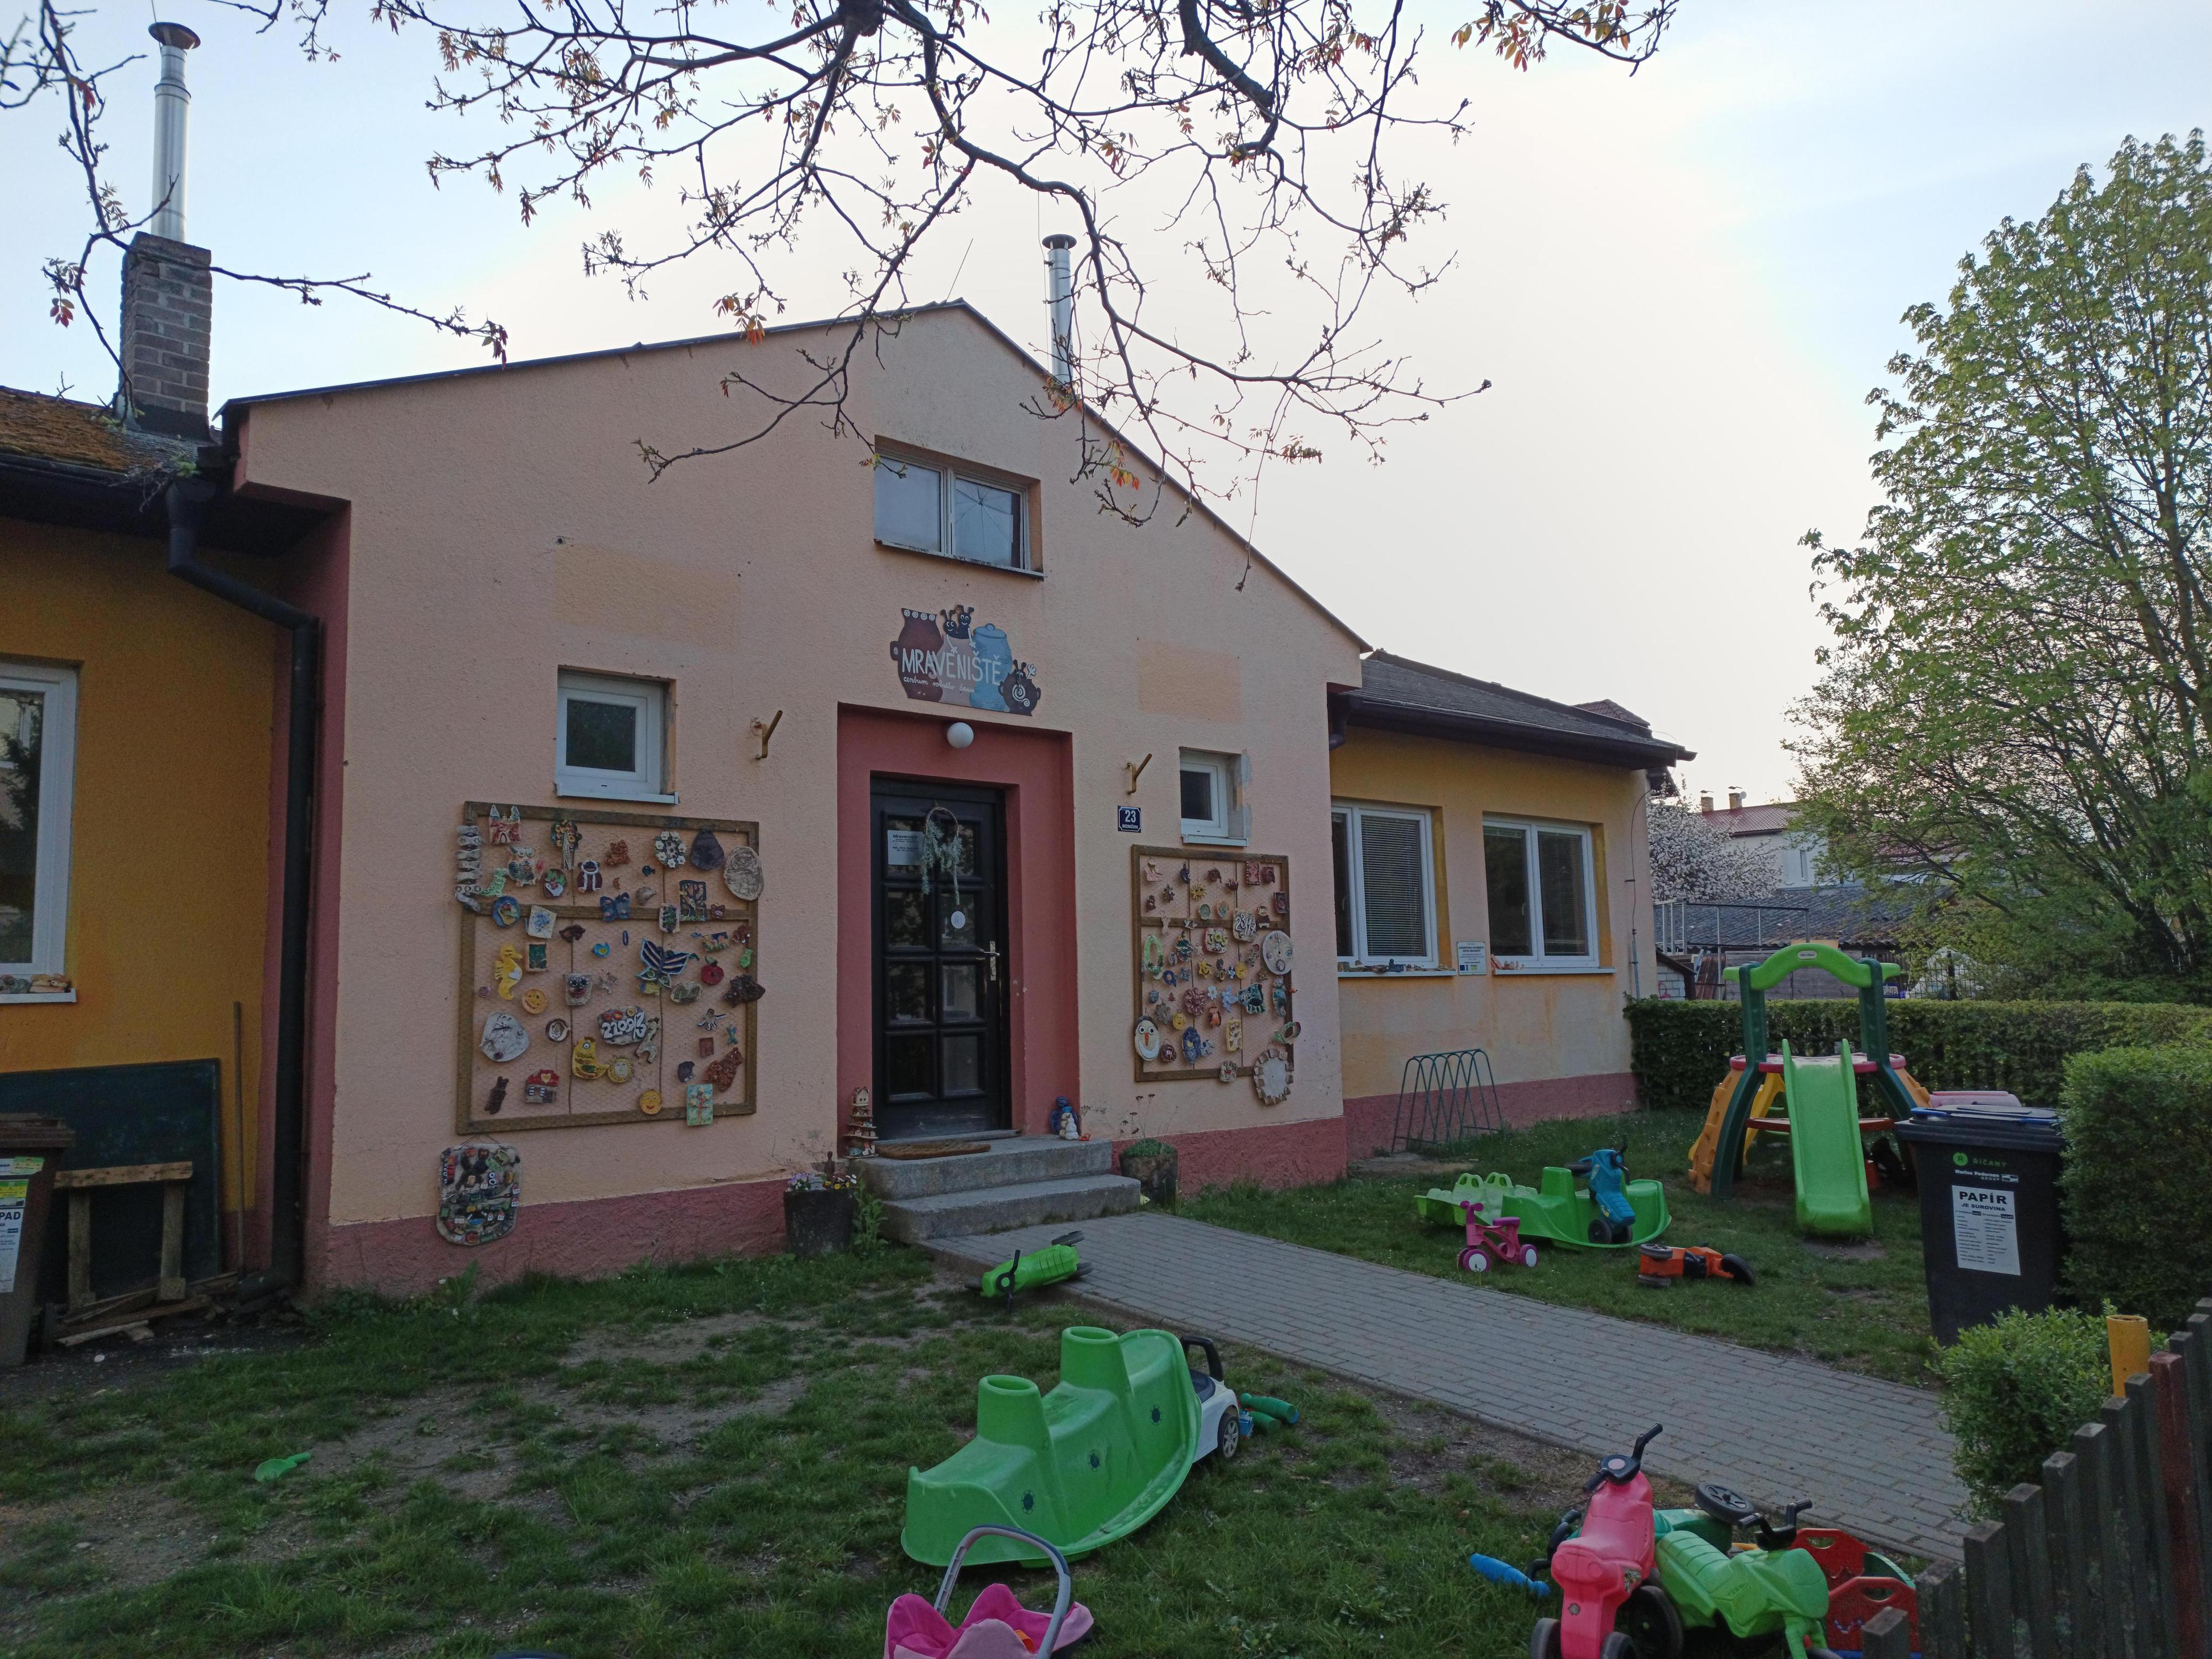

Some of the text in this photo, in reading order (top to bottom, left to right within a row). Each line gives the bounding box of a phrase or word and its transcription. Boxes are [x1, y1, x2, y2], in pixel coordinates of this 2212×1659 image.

[902, 648, 1001, 686] MRAVENIŠTĚ
[903, 675, 928, 685] centrum
[932, 681, 955, 690] volného
[1125, 810, 1136, 823] 23
[1959, 1191, 2008, 1205] PAPÍR
